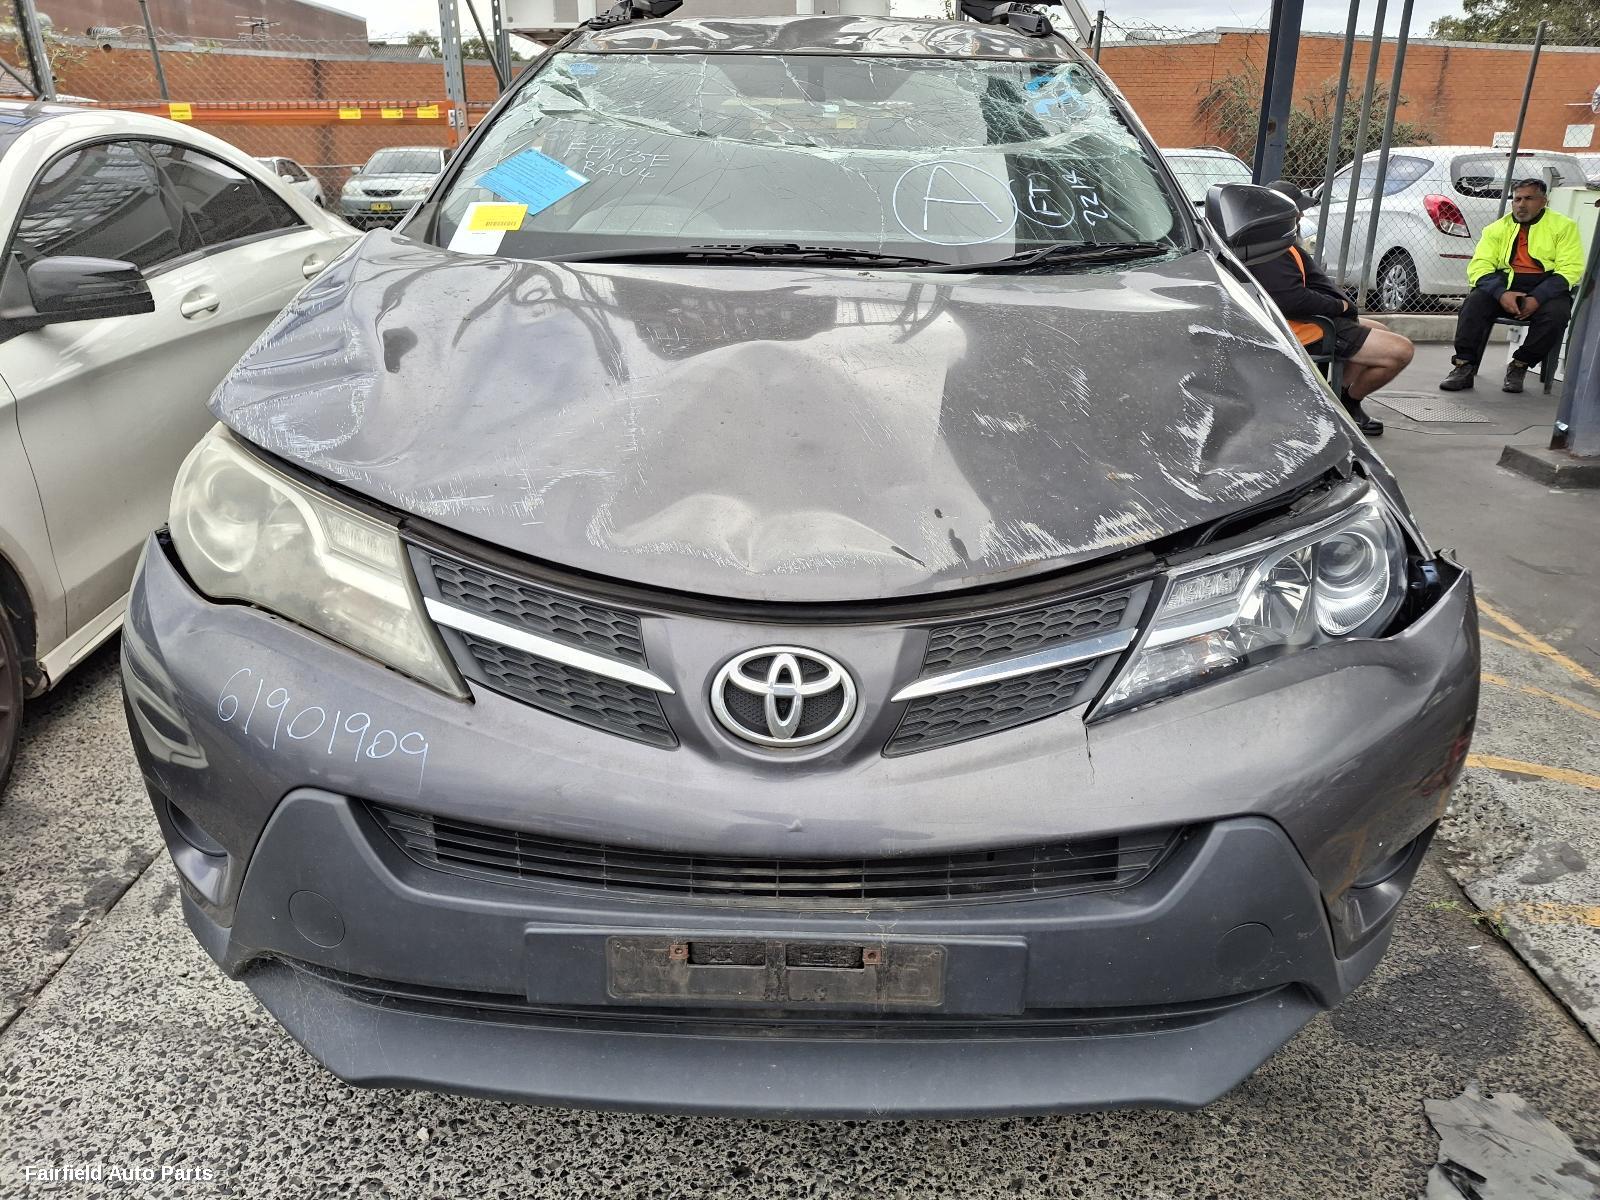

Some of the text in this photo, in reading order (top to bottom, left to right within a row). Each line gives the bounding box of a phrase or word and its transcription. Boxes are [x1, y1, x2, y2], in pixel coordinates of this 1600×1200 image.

[583, 160, 656, 185] RAV4
[923, 165, 1003, 231] A
[217, 668, 429, 794] 61901909
